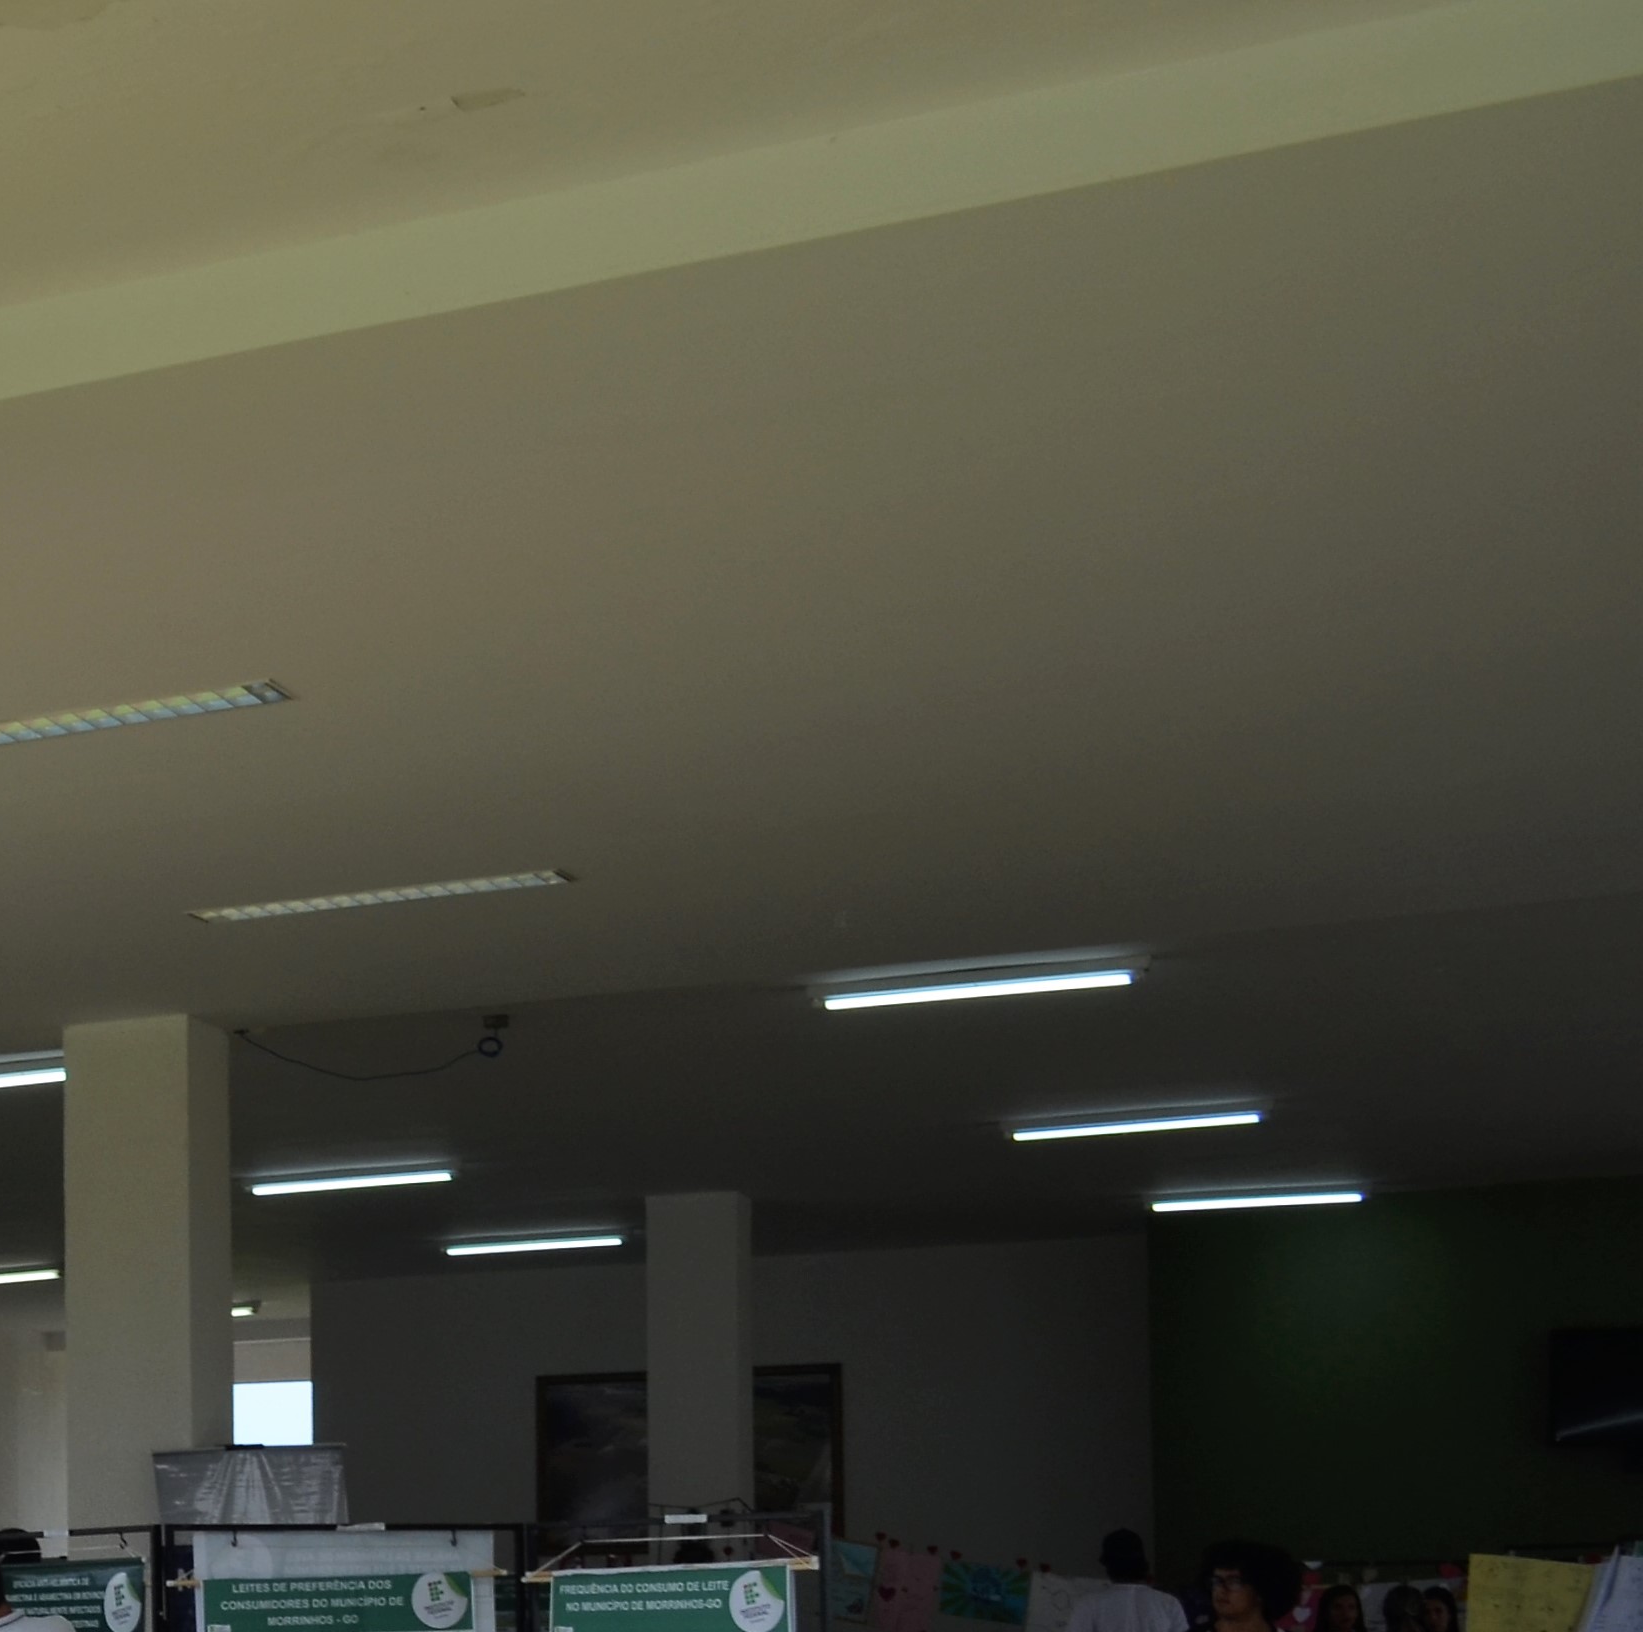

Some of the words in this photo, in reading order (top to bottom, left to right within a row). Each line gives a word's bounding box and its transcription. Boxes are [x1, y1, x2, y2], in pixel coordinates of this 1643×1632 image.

[232, 1582, 270, 1594] LEITES
[272, 1582, 288, 1593] DE
[290, 1578, 365, 1592] PREFERÊNCIA
[368, 1580, 392, 1590] DOS
[559, 1582, 619, 1595] FREQUÊNCIA
[620, 1583, 634, 1594] DO
[635, 1581, 684, 1593] CONSUMO
[686, 1581, 700, 1592] DE
[702, 1580, 730, 1592] LEITE
[220, 1598, 309, 1611] CONSUMIDORES
[312, 1598, 328, 1609] DO
[389, 1596, 404, 1607] DE
[565, 1602, 580, 1612] NO
[631, 1600, 644, 1611] DE
[267, 1615, 334, 1627] MORRINHOS
[343, 1614, 359, 1625] GO
